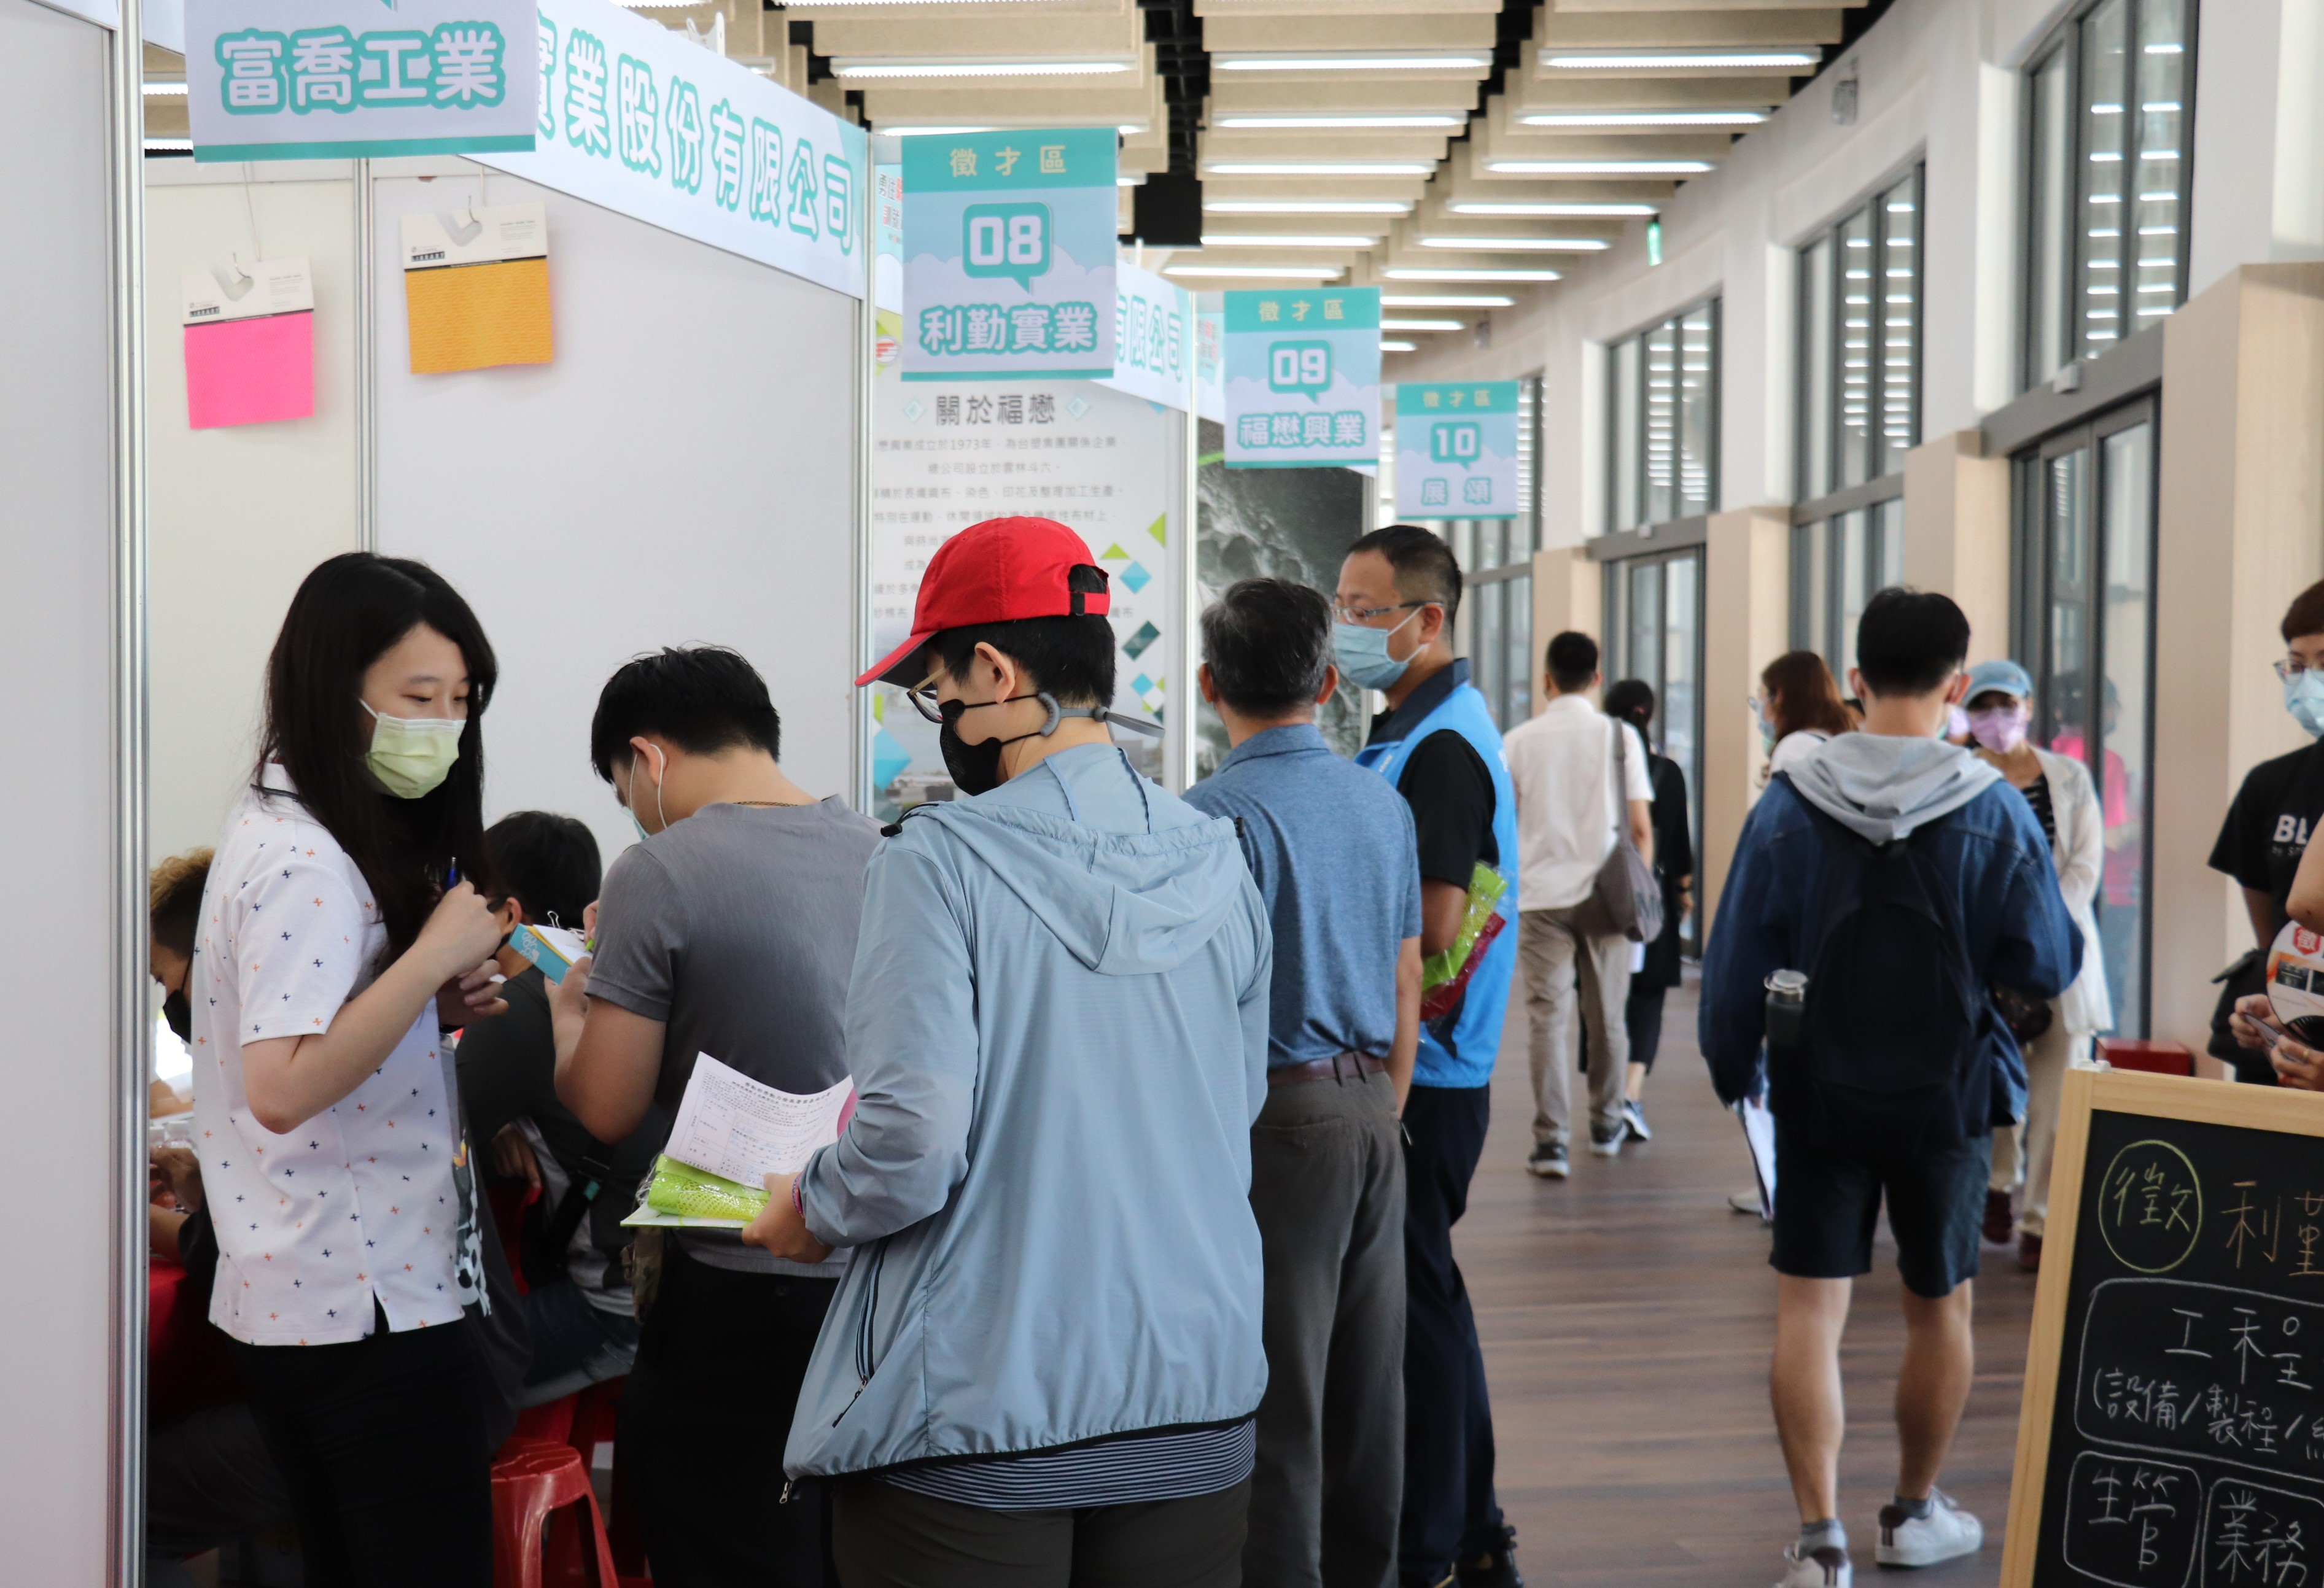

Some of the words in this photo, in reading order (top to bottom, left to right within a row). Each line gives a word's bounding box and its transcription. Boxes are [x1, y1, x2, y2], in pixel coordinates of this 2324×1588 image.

[215, 21, 505, 115] 富喬工業
[950, 145, 1067, 178] 徵才區
[970, 215, 1042, 266] 08
[921, 303, 1097, 355] 利勤實業
[1259, 299, 1345, 322] 徵才區
[1273, 348, 1327, 385] 09
[936, 395, 1055, 425] 關於福懋
[1423, 389, 1491, 408] 徵才區
[1238, 411, 1365, 449] 福懋興業
[1436, 428, 1475, 457] 10
[2114, 1163, 2193, 1232] 徵
[2164, 1307, 2313, 1389] 工程
[2216, 1490, 2309, 1587] 業務
